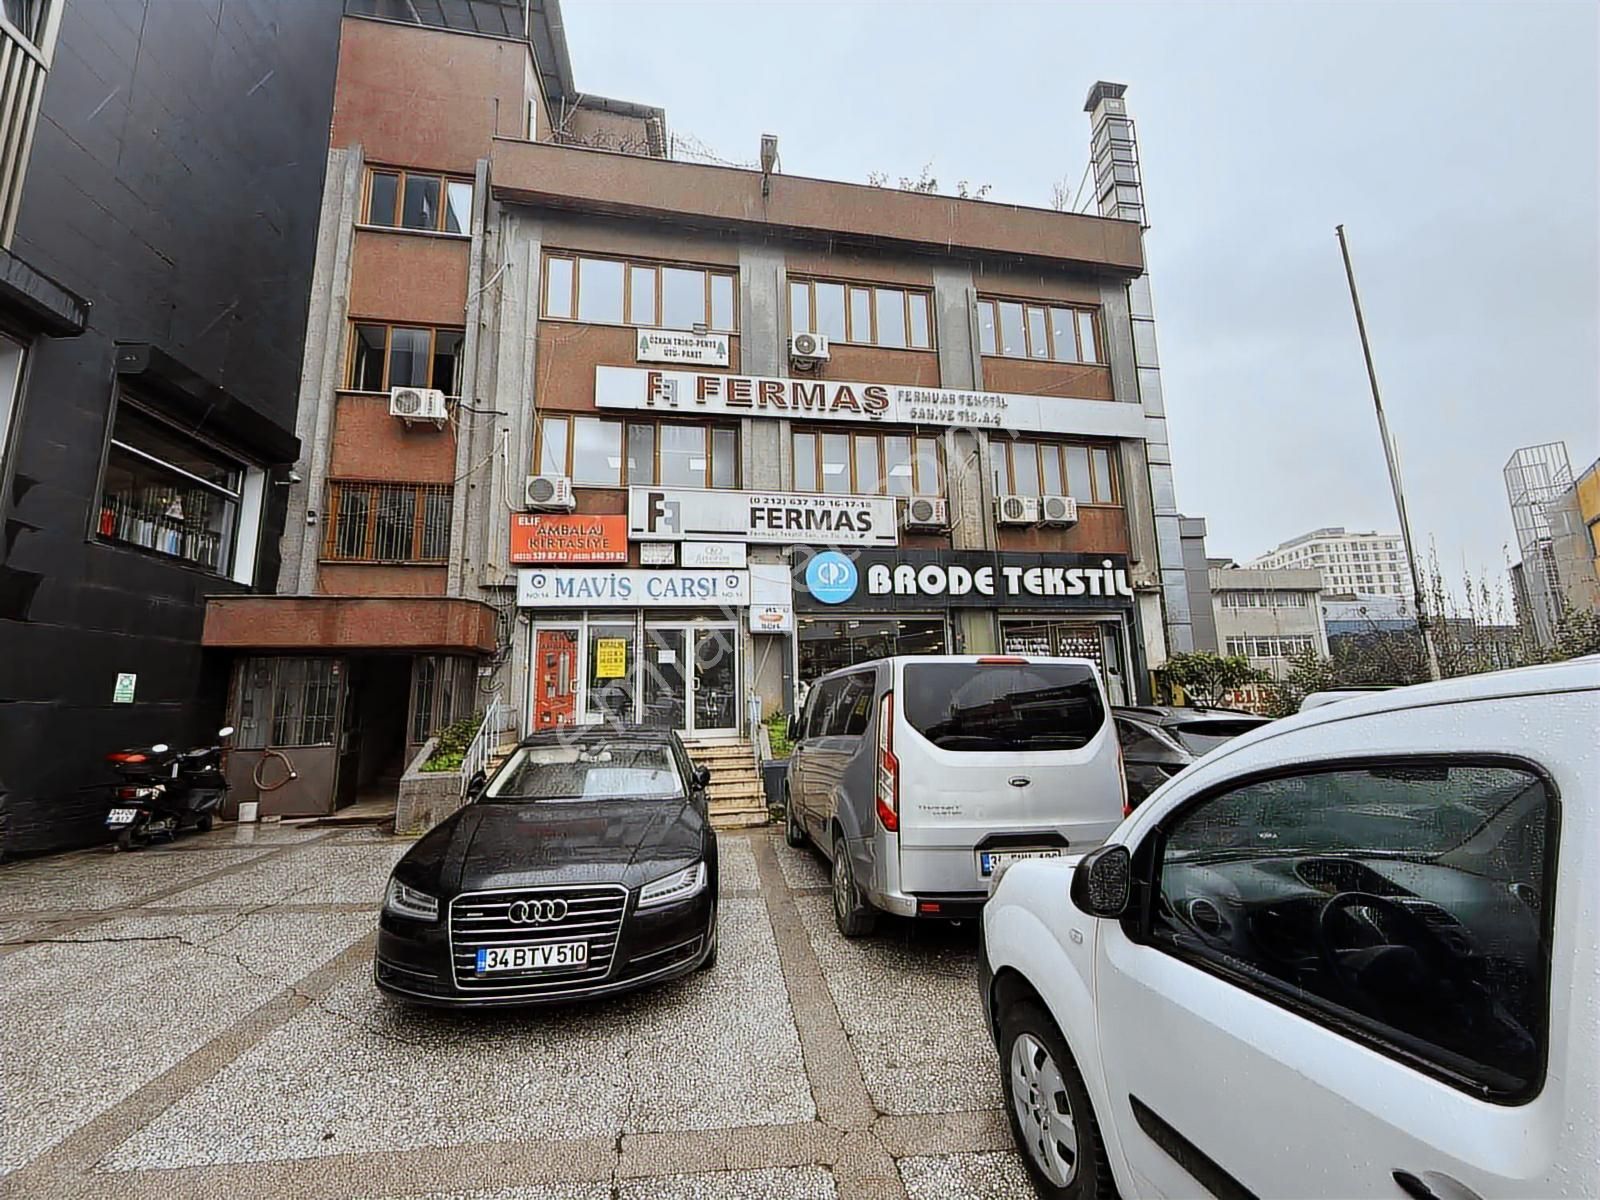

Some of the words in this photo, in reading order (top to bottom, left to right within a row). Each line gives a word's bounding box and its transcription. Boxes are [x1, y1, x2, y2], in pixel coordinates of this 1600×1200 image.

[696, 376, 890, 420] FERMAŞ
[897, 390, 956, 405] FERMUAR
[536, 523, 605, 537] AMBALAJ
[749, 506, 873, 539] FERMAŞ
[555, 573, 632, 600] MAVİŞ
[647, 577, 718, 600] ÇARŞI
[868, 564, 995, 596] BRODE
[1002, 559, 1134, 602] TEKSTİL
[487, 950, 509, 969] 34
[513, 947, 554, 967] BTV
[556, 944, 586, 963] 510
